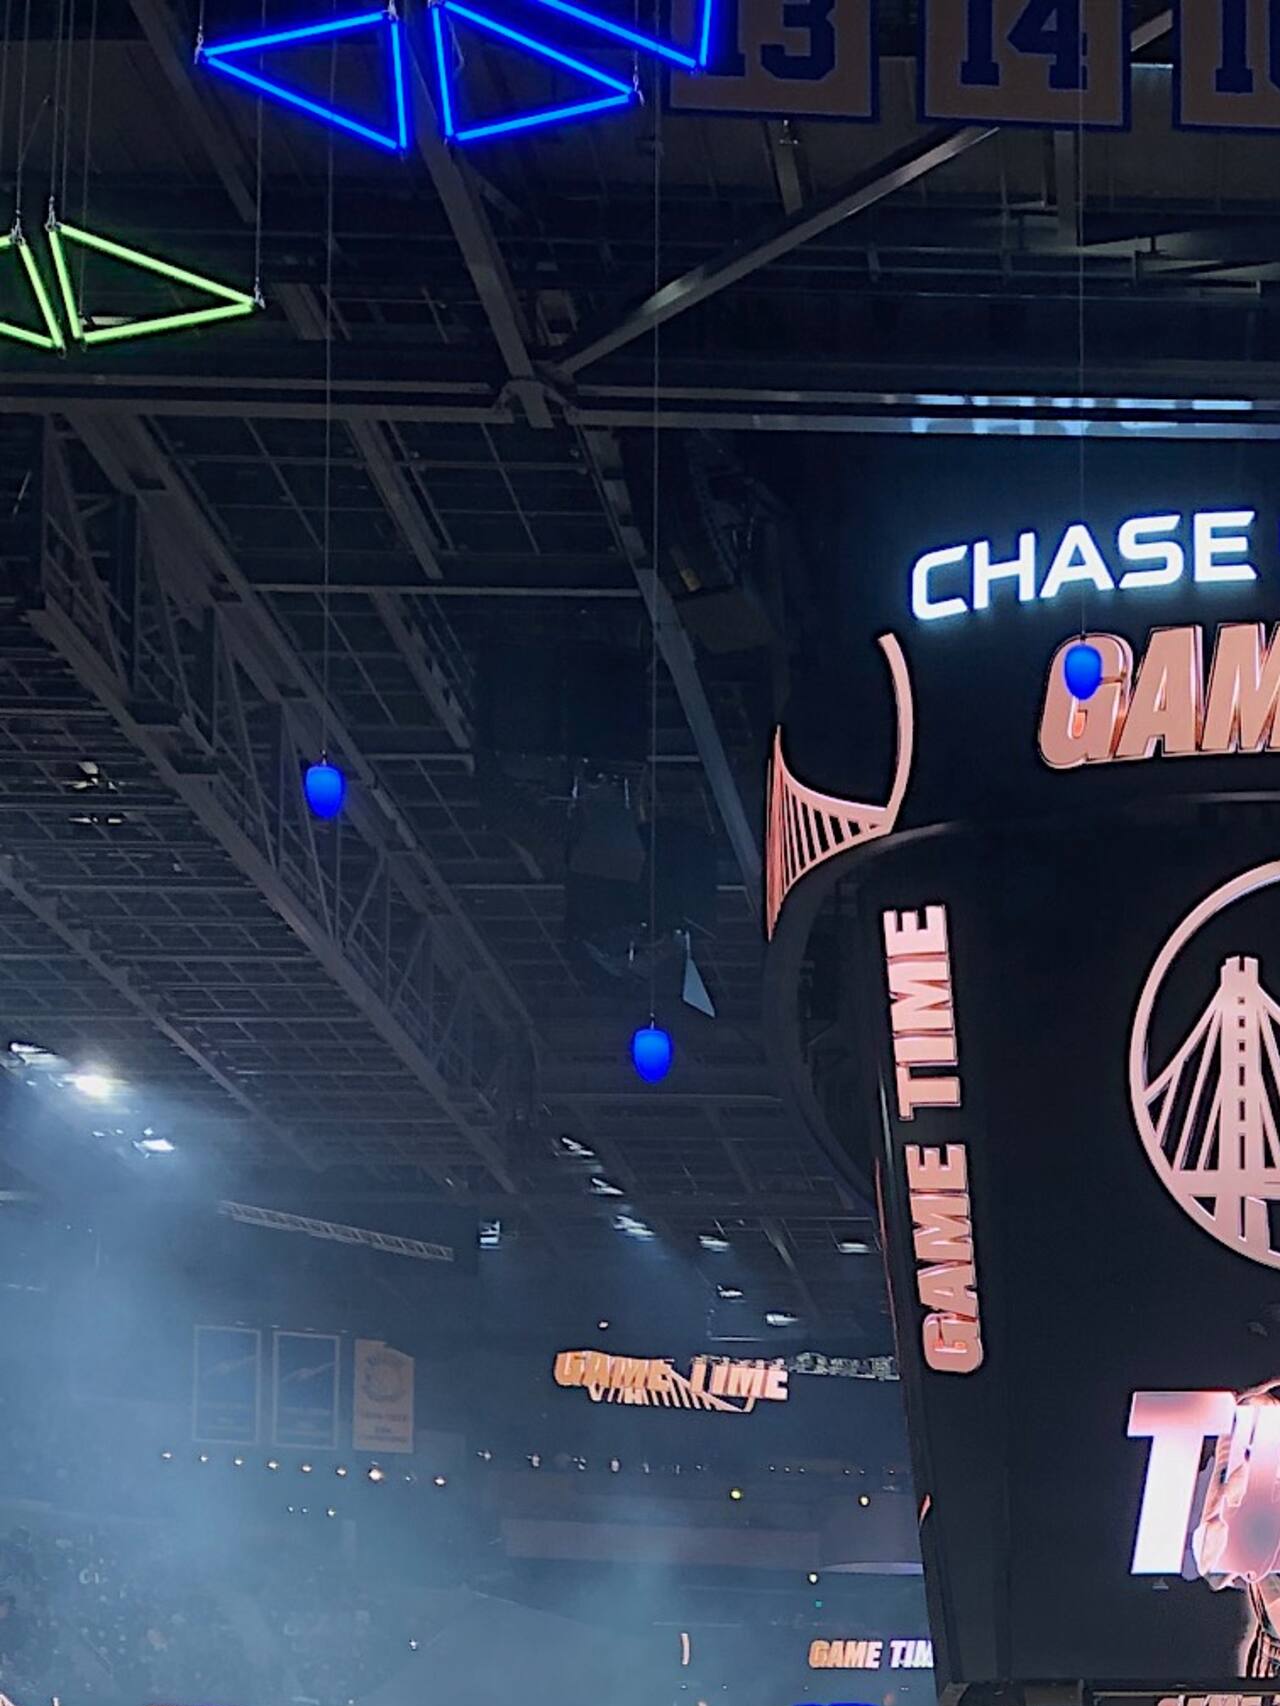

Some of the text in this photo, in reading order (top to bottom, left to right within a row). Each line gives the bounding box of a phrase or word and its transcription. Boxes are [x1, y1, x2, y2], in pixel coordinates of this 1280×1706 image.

[697, 0, 837, 79] 13
[960, 0, 1087, 90] 14
[910, 508, 1259, 621] CHASE
[882, 904, 961, 1122] TIME
[904, 1143, 983, 1373] GAME
[808, 1640, 934, 1669] GAME TIM
